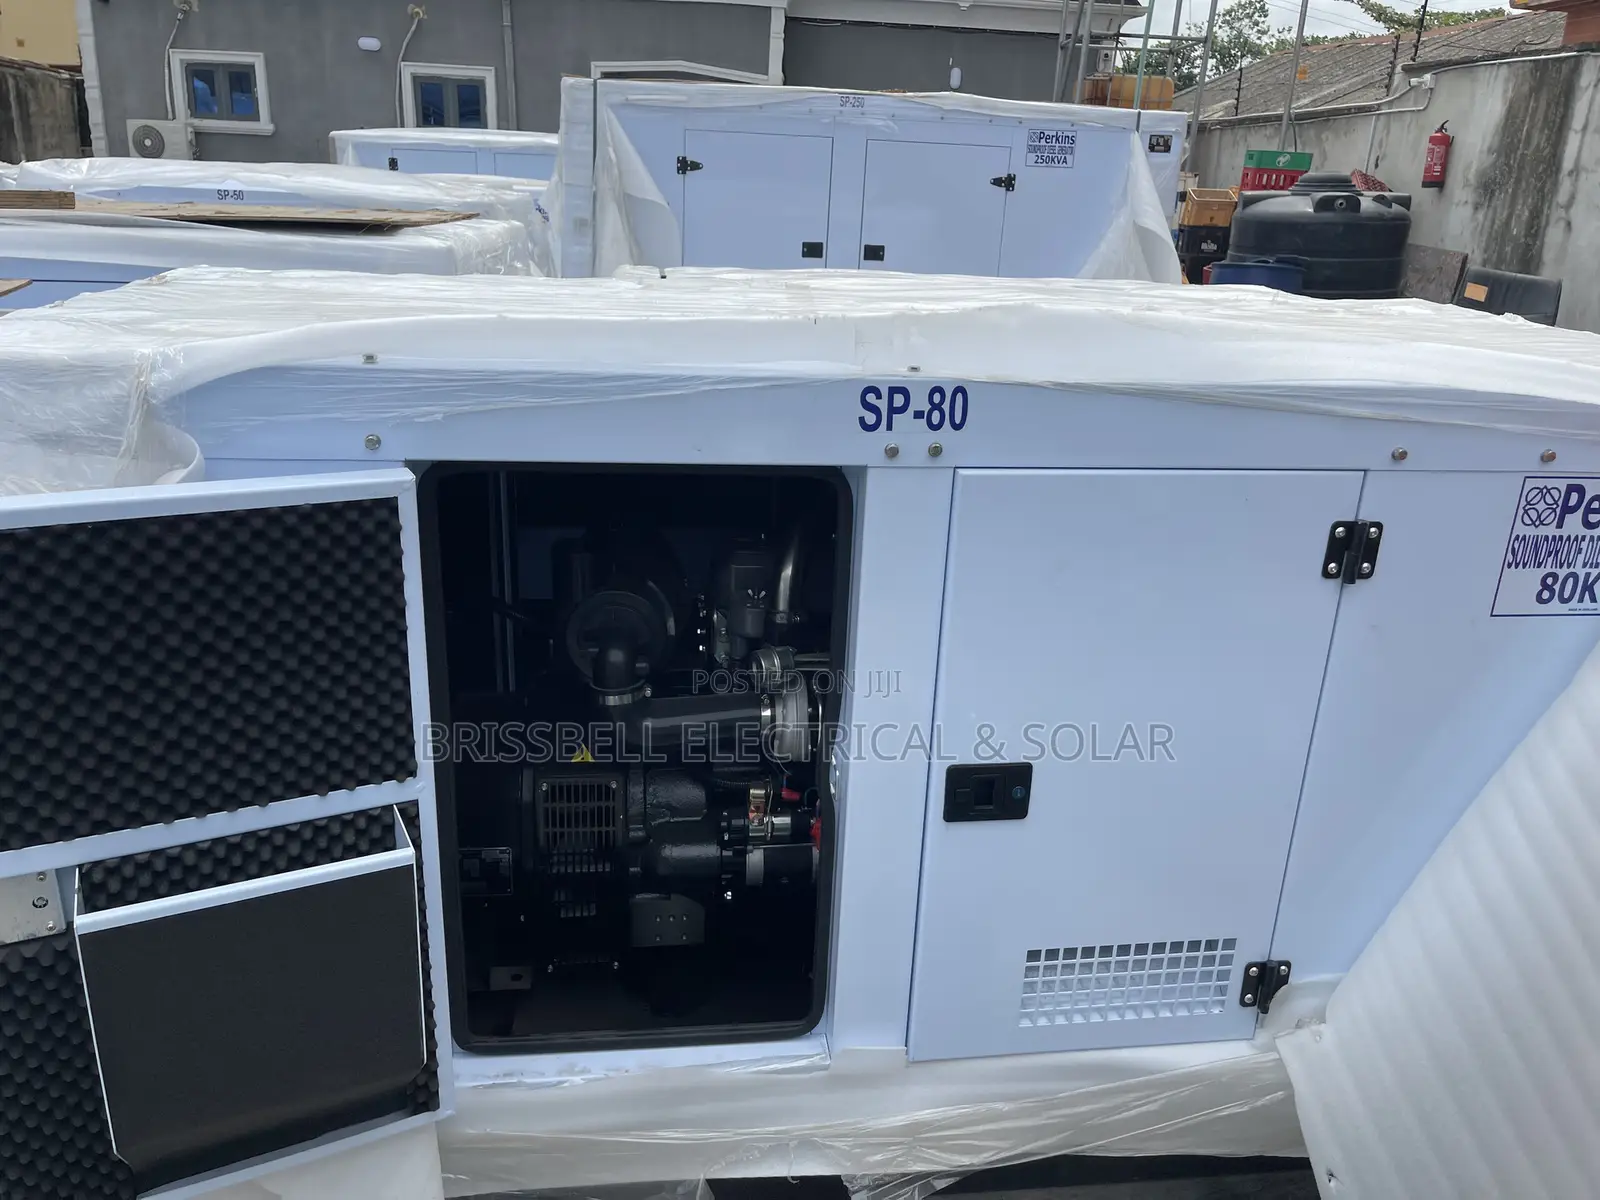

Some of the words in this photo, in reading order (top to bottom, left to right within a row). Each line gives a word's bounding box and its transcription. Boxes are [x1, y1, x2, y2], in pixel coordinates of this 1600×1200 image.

[840, 96, 865, 108] SP-250
[1038, 131, 1075, 145] Perkins
[1034, 154, 1068, 165] 250KVA
[217, 189, 244, 201] SP-50
[858, 385, 968, 432] SP-80
[1507, 534, 1586, 569] SOUNDPROOF
[1535, 571, 1600, 604] 80K
